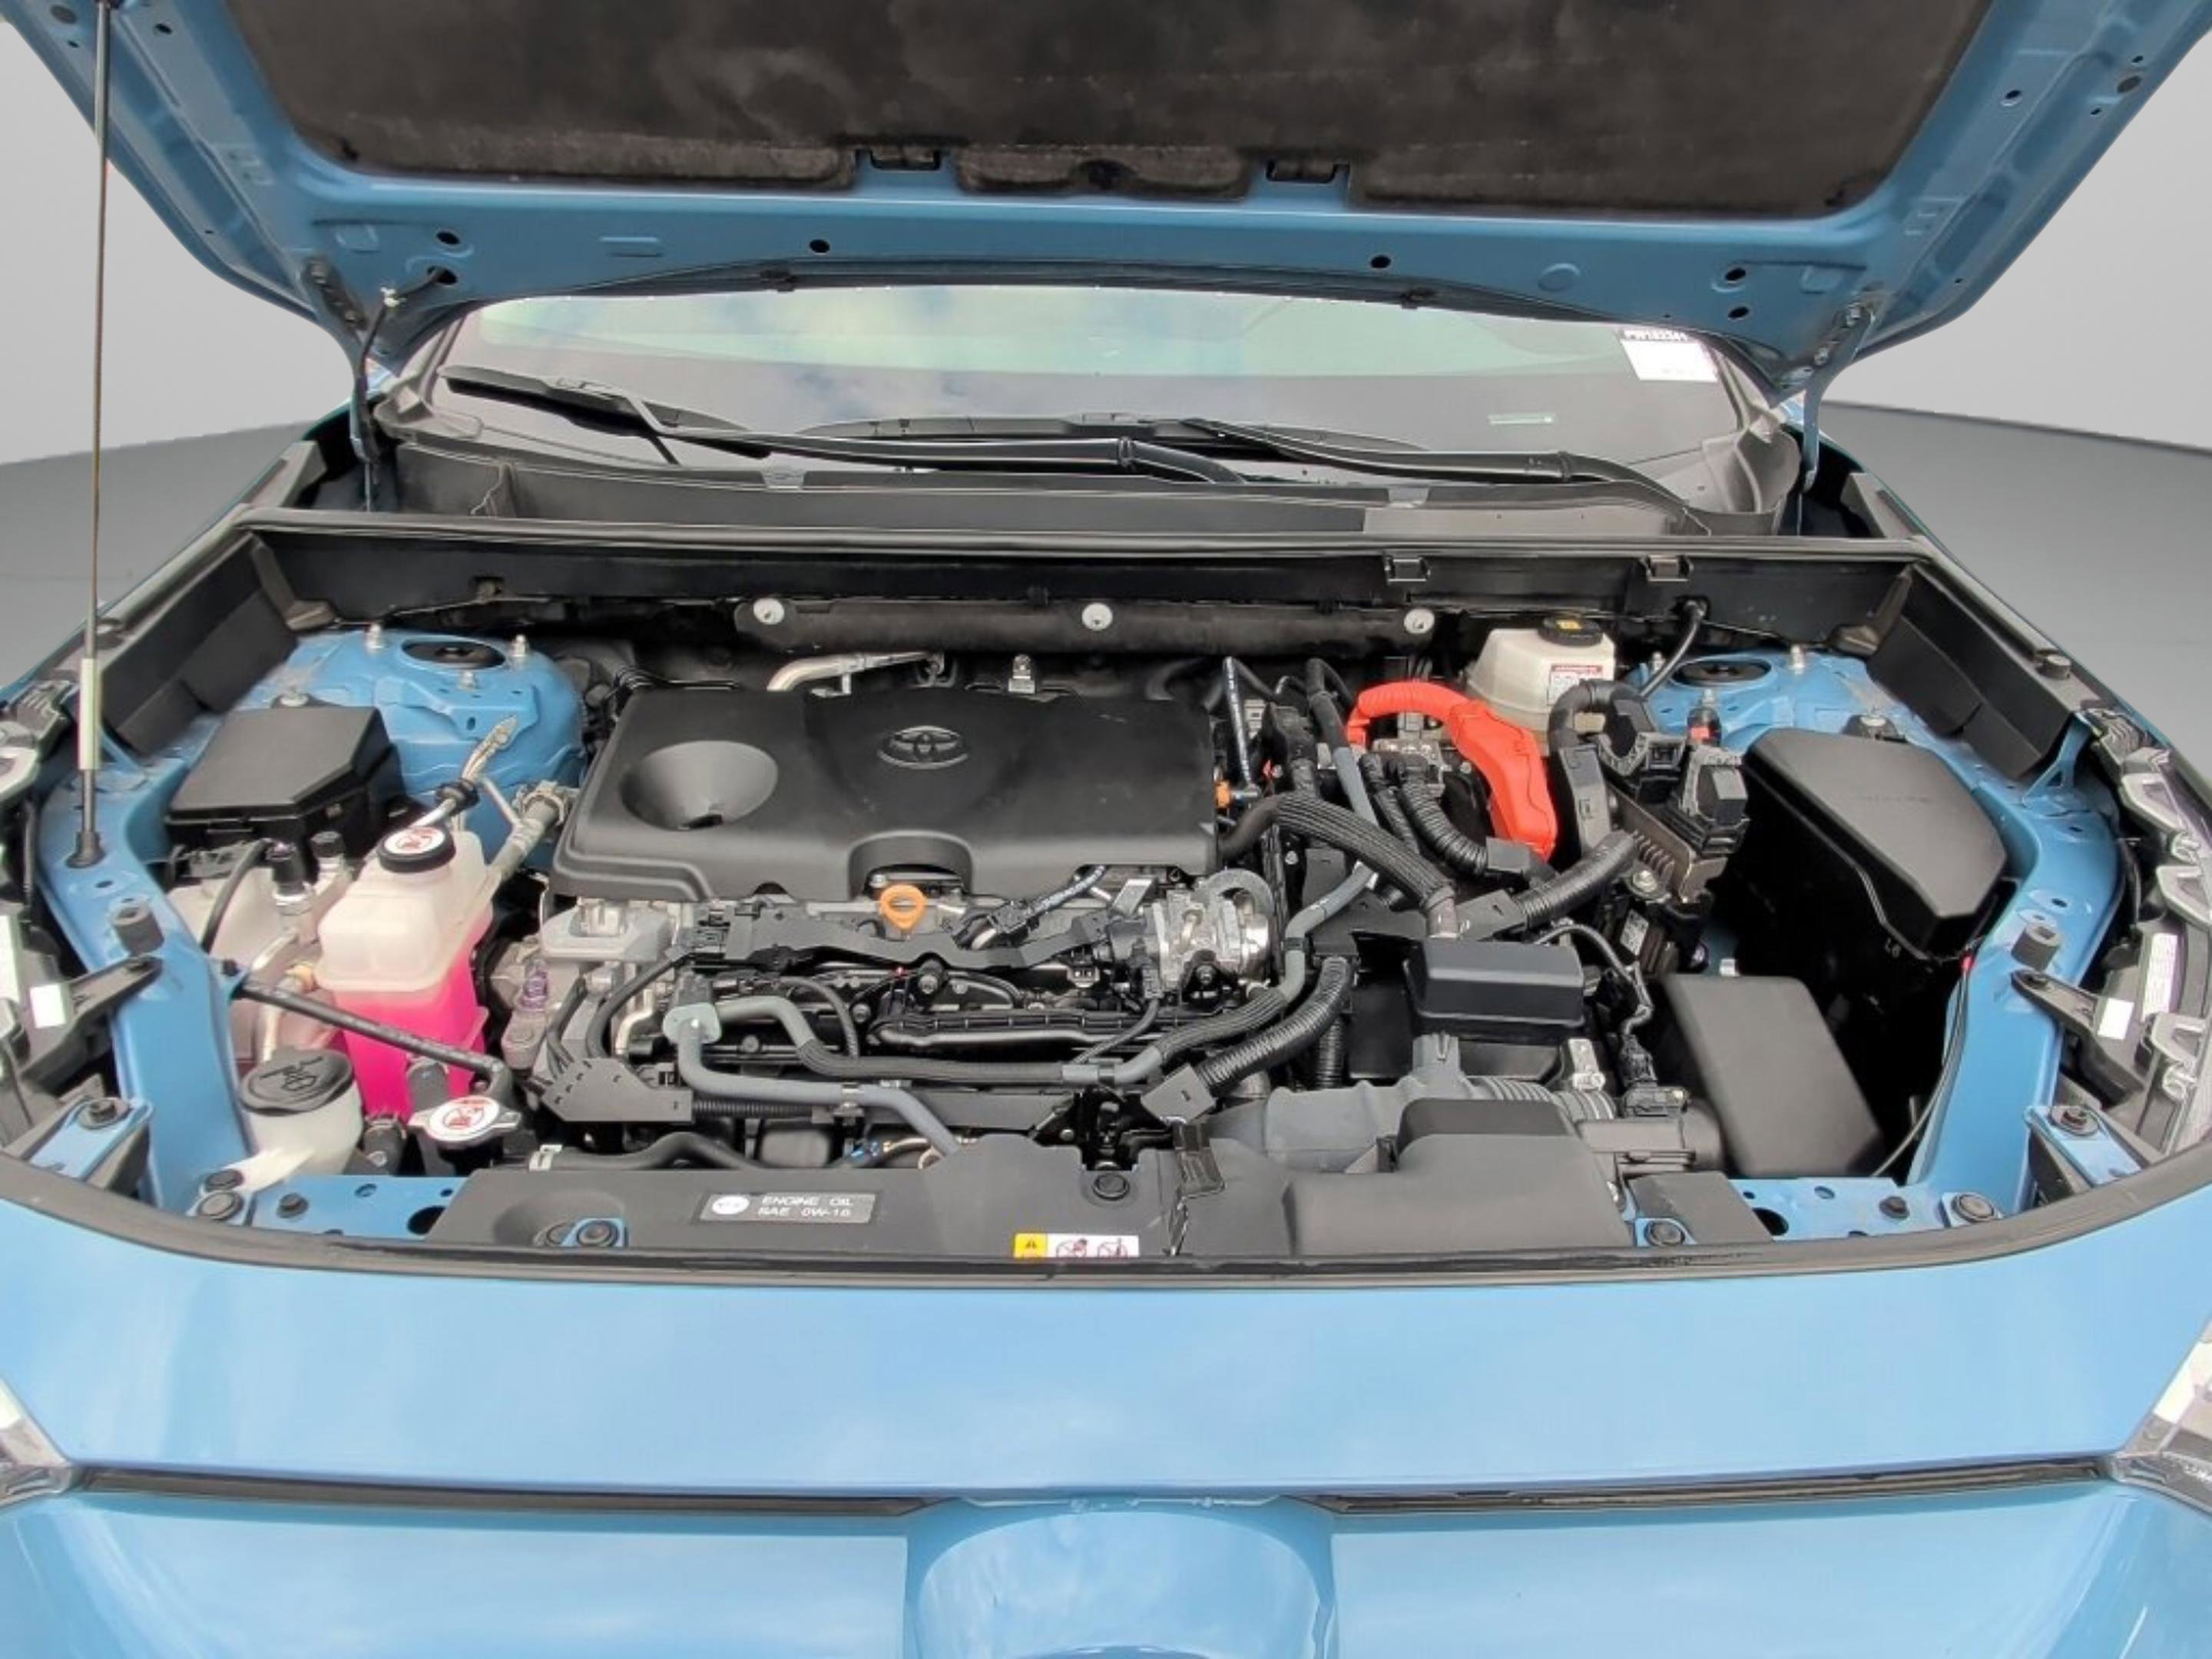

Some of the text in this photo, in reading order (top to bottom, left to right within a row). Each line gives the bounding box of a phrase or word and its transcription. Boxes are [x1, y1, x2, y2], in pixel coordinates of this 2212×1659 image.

[762, 1196, 855, 1207] ENGINE OIL
[757, 1207, 791, 1217] SAE
